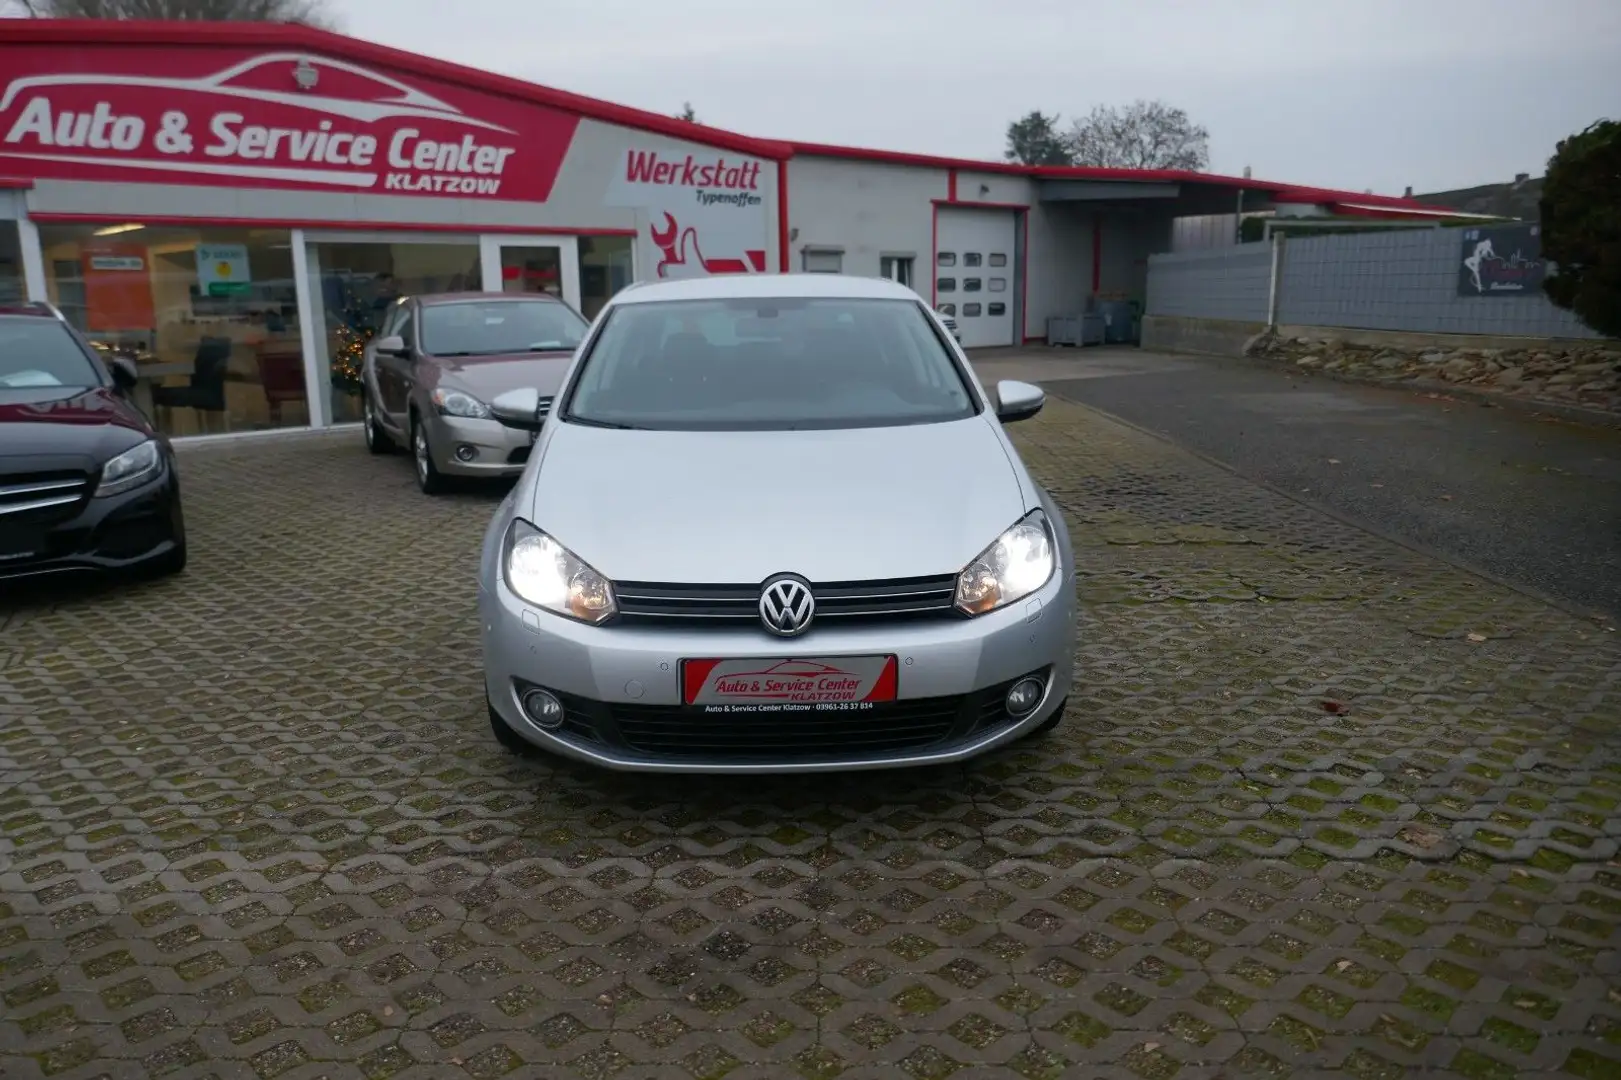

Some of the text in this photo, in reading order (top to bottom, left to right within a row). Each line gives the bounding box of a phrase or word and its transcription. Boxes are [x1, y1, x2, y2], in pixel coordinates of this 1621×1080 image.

[4, 96, 516, 174] Auto & Service Center
[626, 150, 761, 190] Werkstatt
[384, 172, 501, 195] KLATZOW
[695, 189, 762, 207] Typenoffen
[716, 678, 861, 693] Auto & Service Center
[791, 691, 855, 700] KLATZOW
[705, 705, 723, 713] Auto
[724, 705, 730, 713] &
[731, 704, 757, 712] Service
[758, 704, 782, 712] Center
[783, 703, 811, 712] Klatzow
